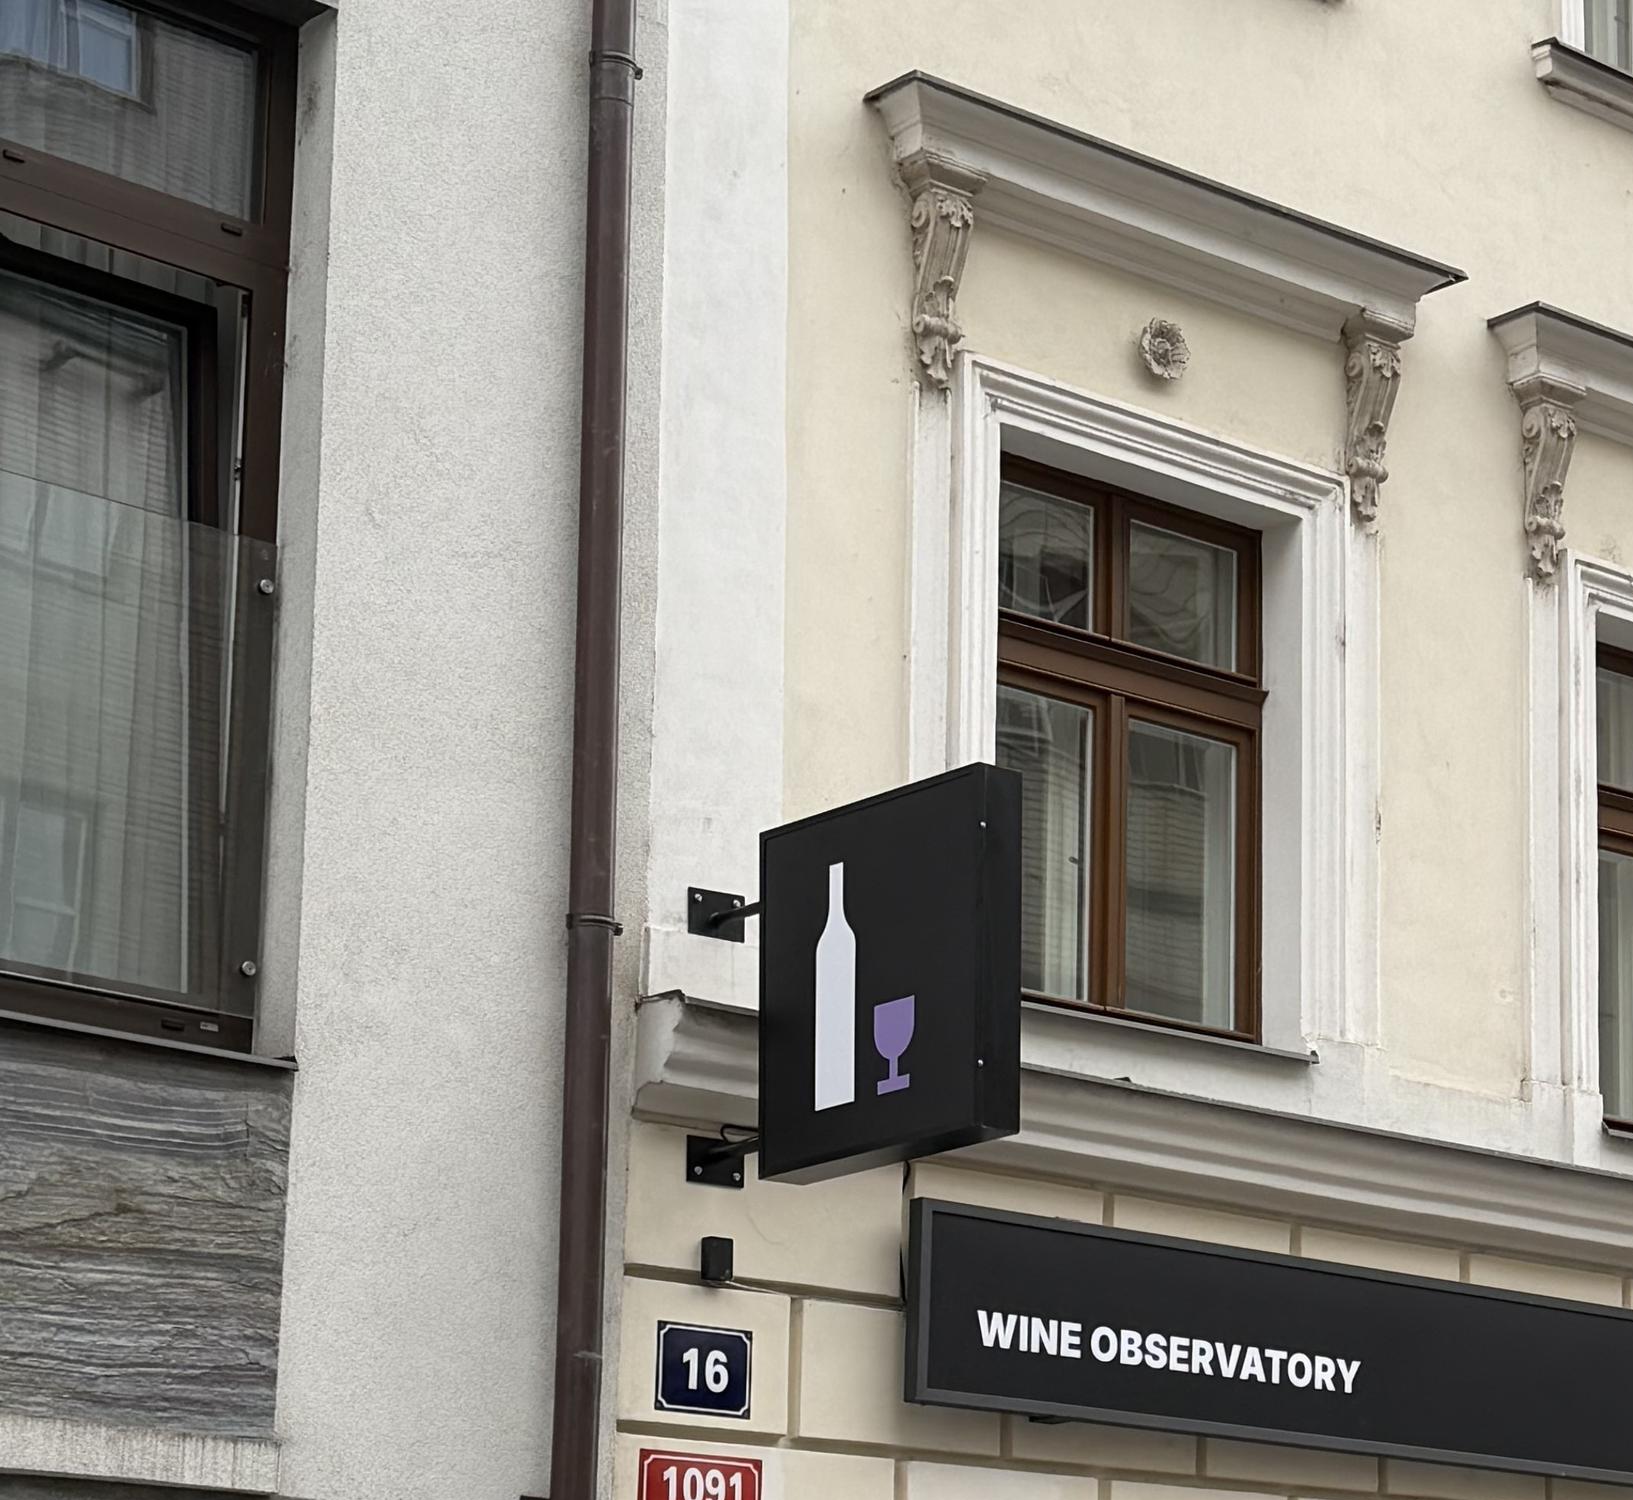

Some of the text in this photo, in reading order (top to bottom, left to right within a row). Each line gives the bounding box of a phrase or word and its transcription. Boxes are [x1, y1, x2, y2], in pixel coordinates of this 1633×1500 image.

[683, 1348, 729, 1393] 16
[977, 1310, 1361, 1394] WINE OBSERVATORY
